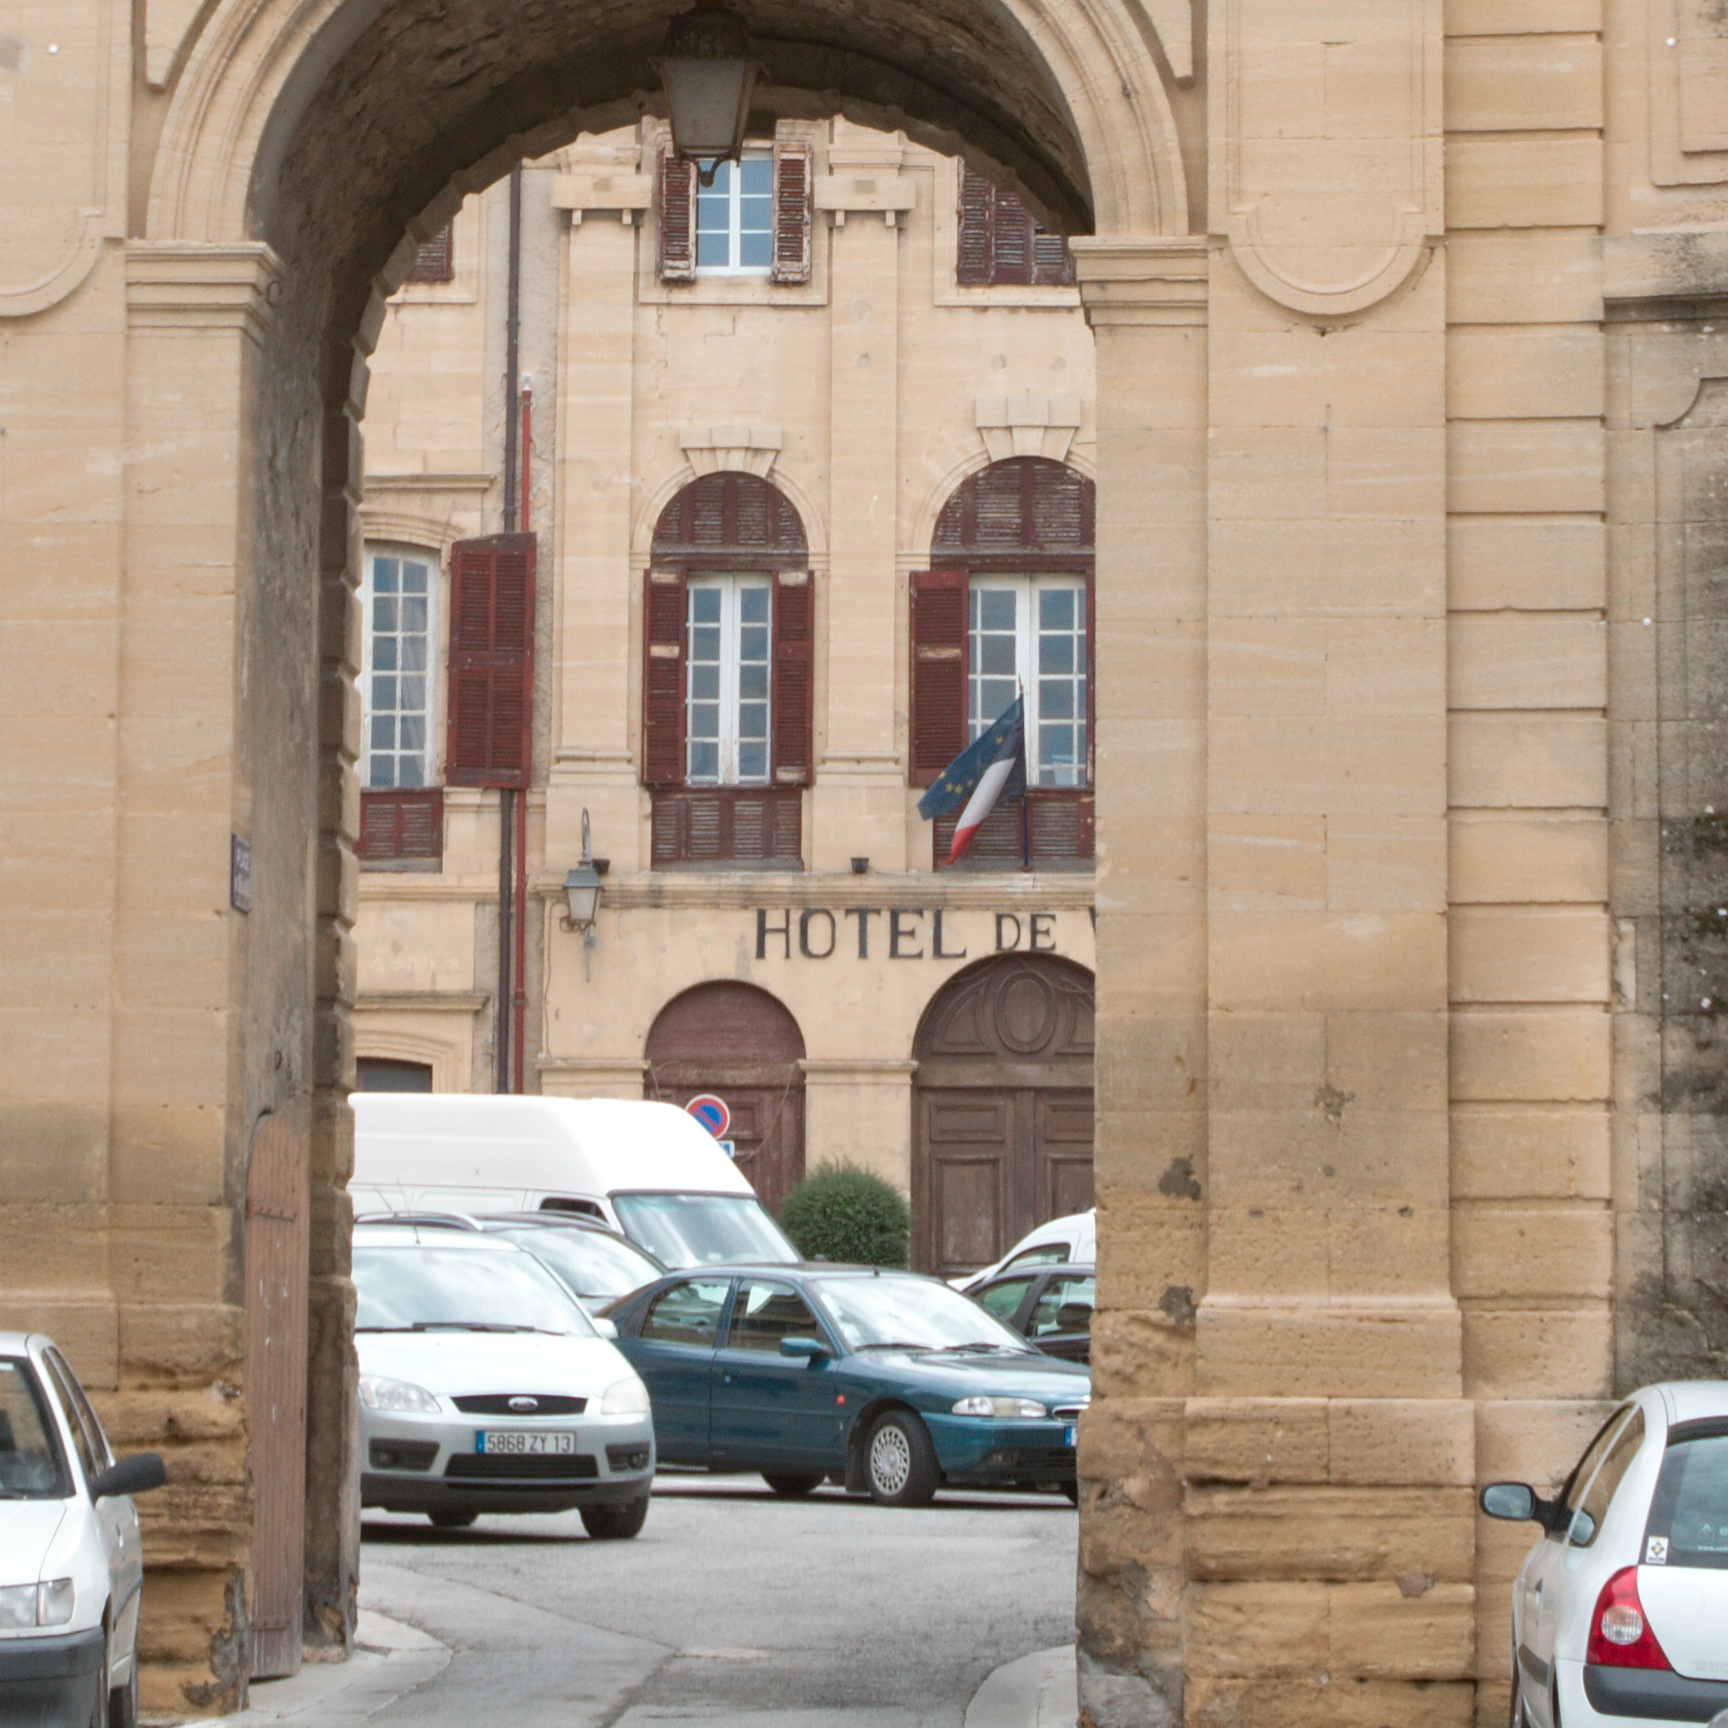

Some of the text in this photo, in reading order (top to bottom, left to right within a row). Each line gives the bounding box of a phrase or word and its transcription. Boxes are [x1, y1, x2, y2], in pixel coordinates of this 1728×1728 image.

[754, 907, 968, 960] HOTEL
[994, 911, 1058, 952] DE
[487, 1434, 526, 1452] 5868
[529, 1434, 548, 1452] ZY
[554, 1434, 571, 1452] 13
